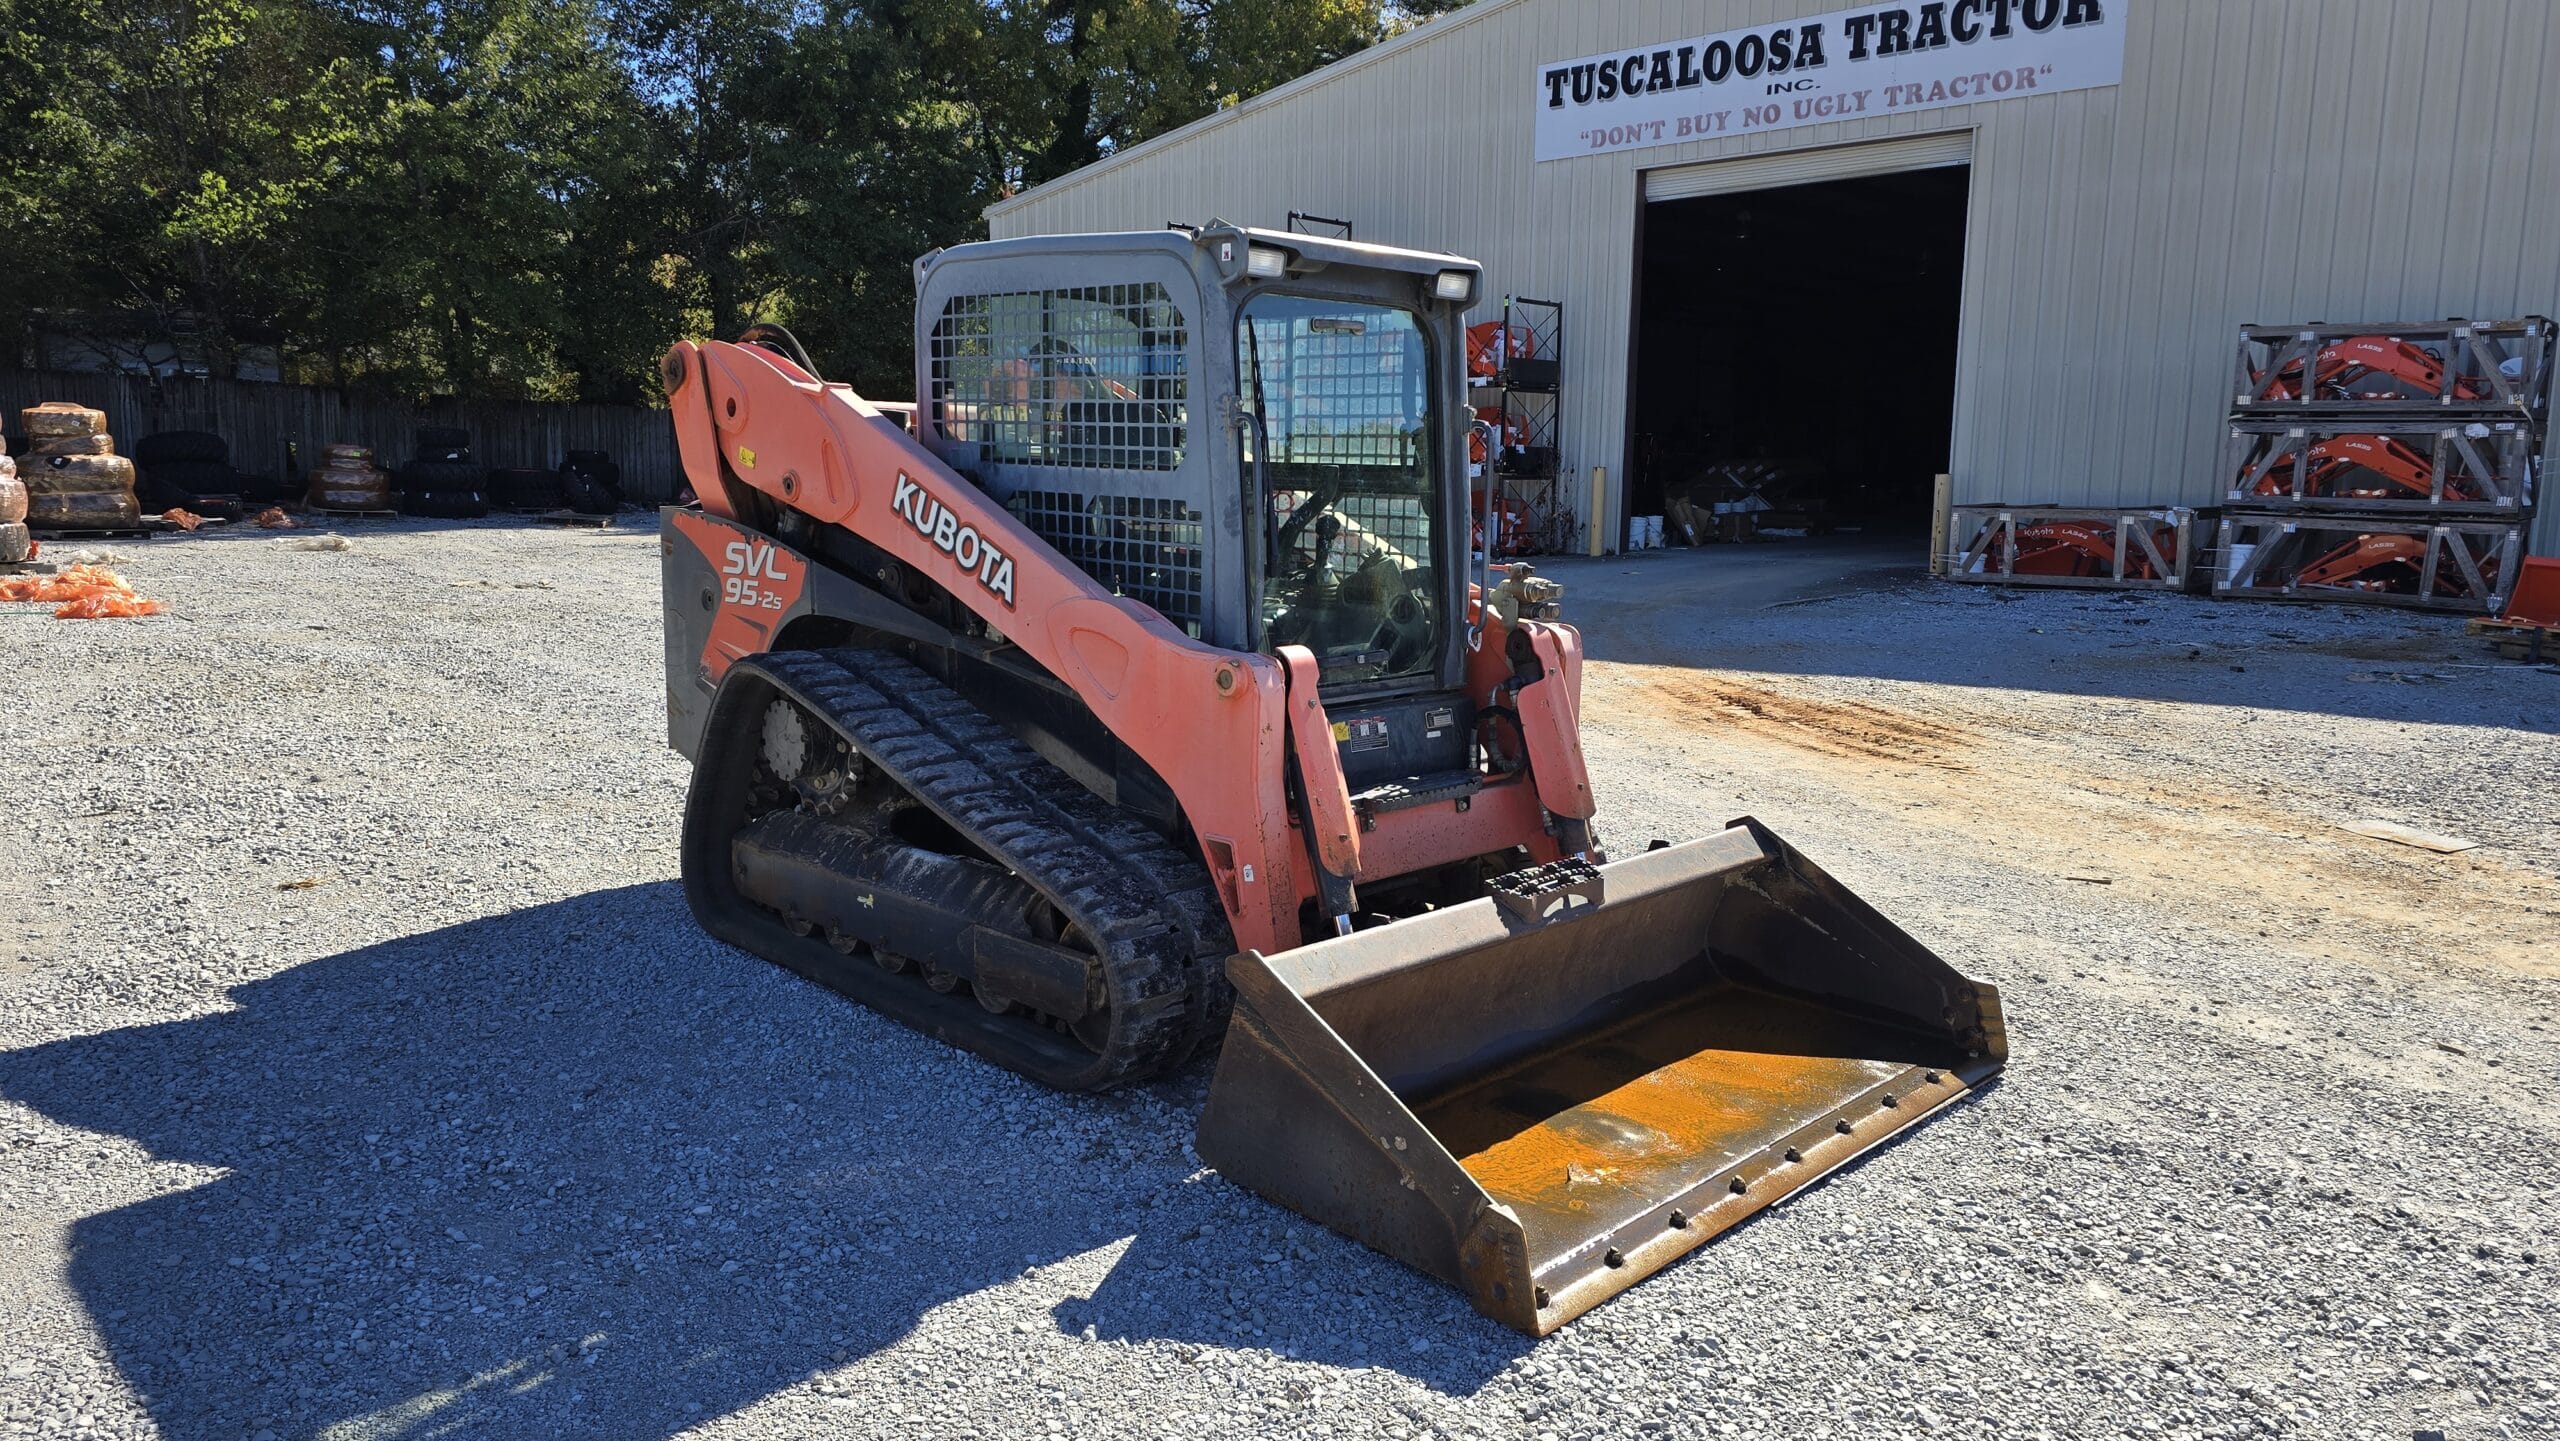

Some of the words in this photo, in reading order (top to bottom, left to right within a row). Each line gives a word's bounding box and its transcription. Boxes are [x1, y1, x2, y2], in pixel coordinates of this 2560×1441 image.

[1546, 23, 1826, 108] TUSCALOOSA
[1766, 79, 1821, 95] INC.
[1676, 110, 1732, 137] BUY
[1743, 104, 1781, 127] NO
[1793, 90, 1872, 119] UGLY
[2299, 350, 2336, 365] Kota
[2289, 446, 2326, 460] Kota
[892, 473, 1013, 604] KUBOTA
[723, 541, 787, 580] SVL
